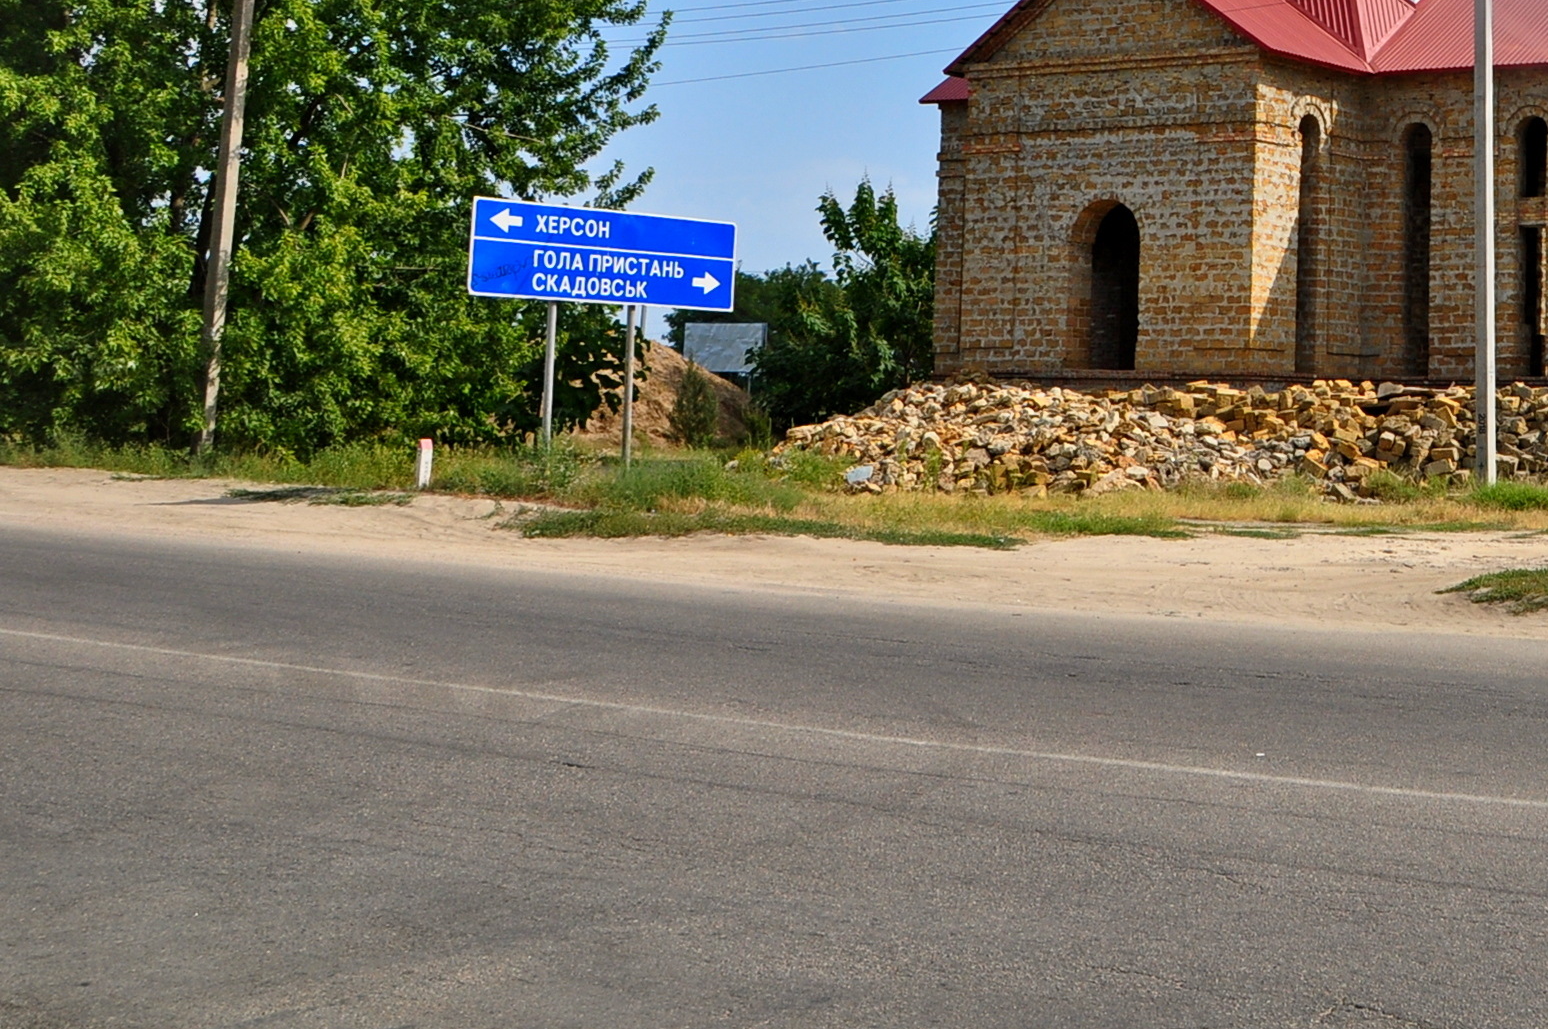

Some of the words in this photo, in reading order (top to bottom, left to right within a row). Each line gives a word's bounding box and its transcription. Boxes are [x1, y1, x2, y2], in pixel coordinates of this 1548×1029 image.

[535, 214, 610, 239] ХЕРСОН
[533, 249, 584, 271] ГОЛА
[588, 254, 684, 279] ПРИСТАНЬ
[532, 272, 648, 298] СКАДОВСЬК
